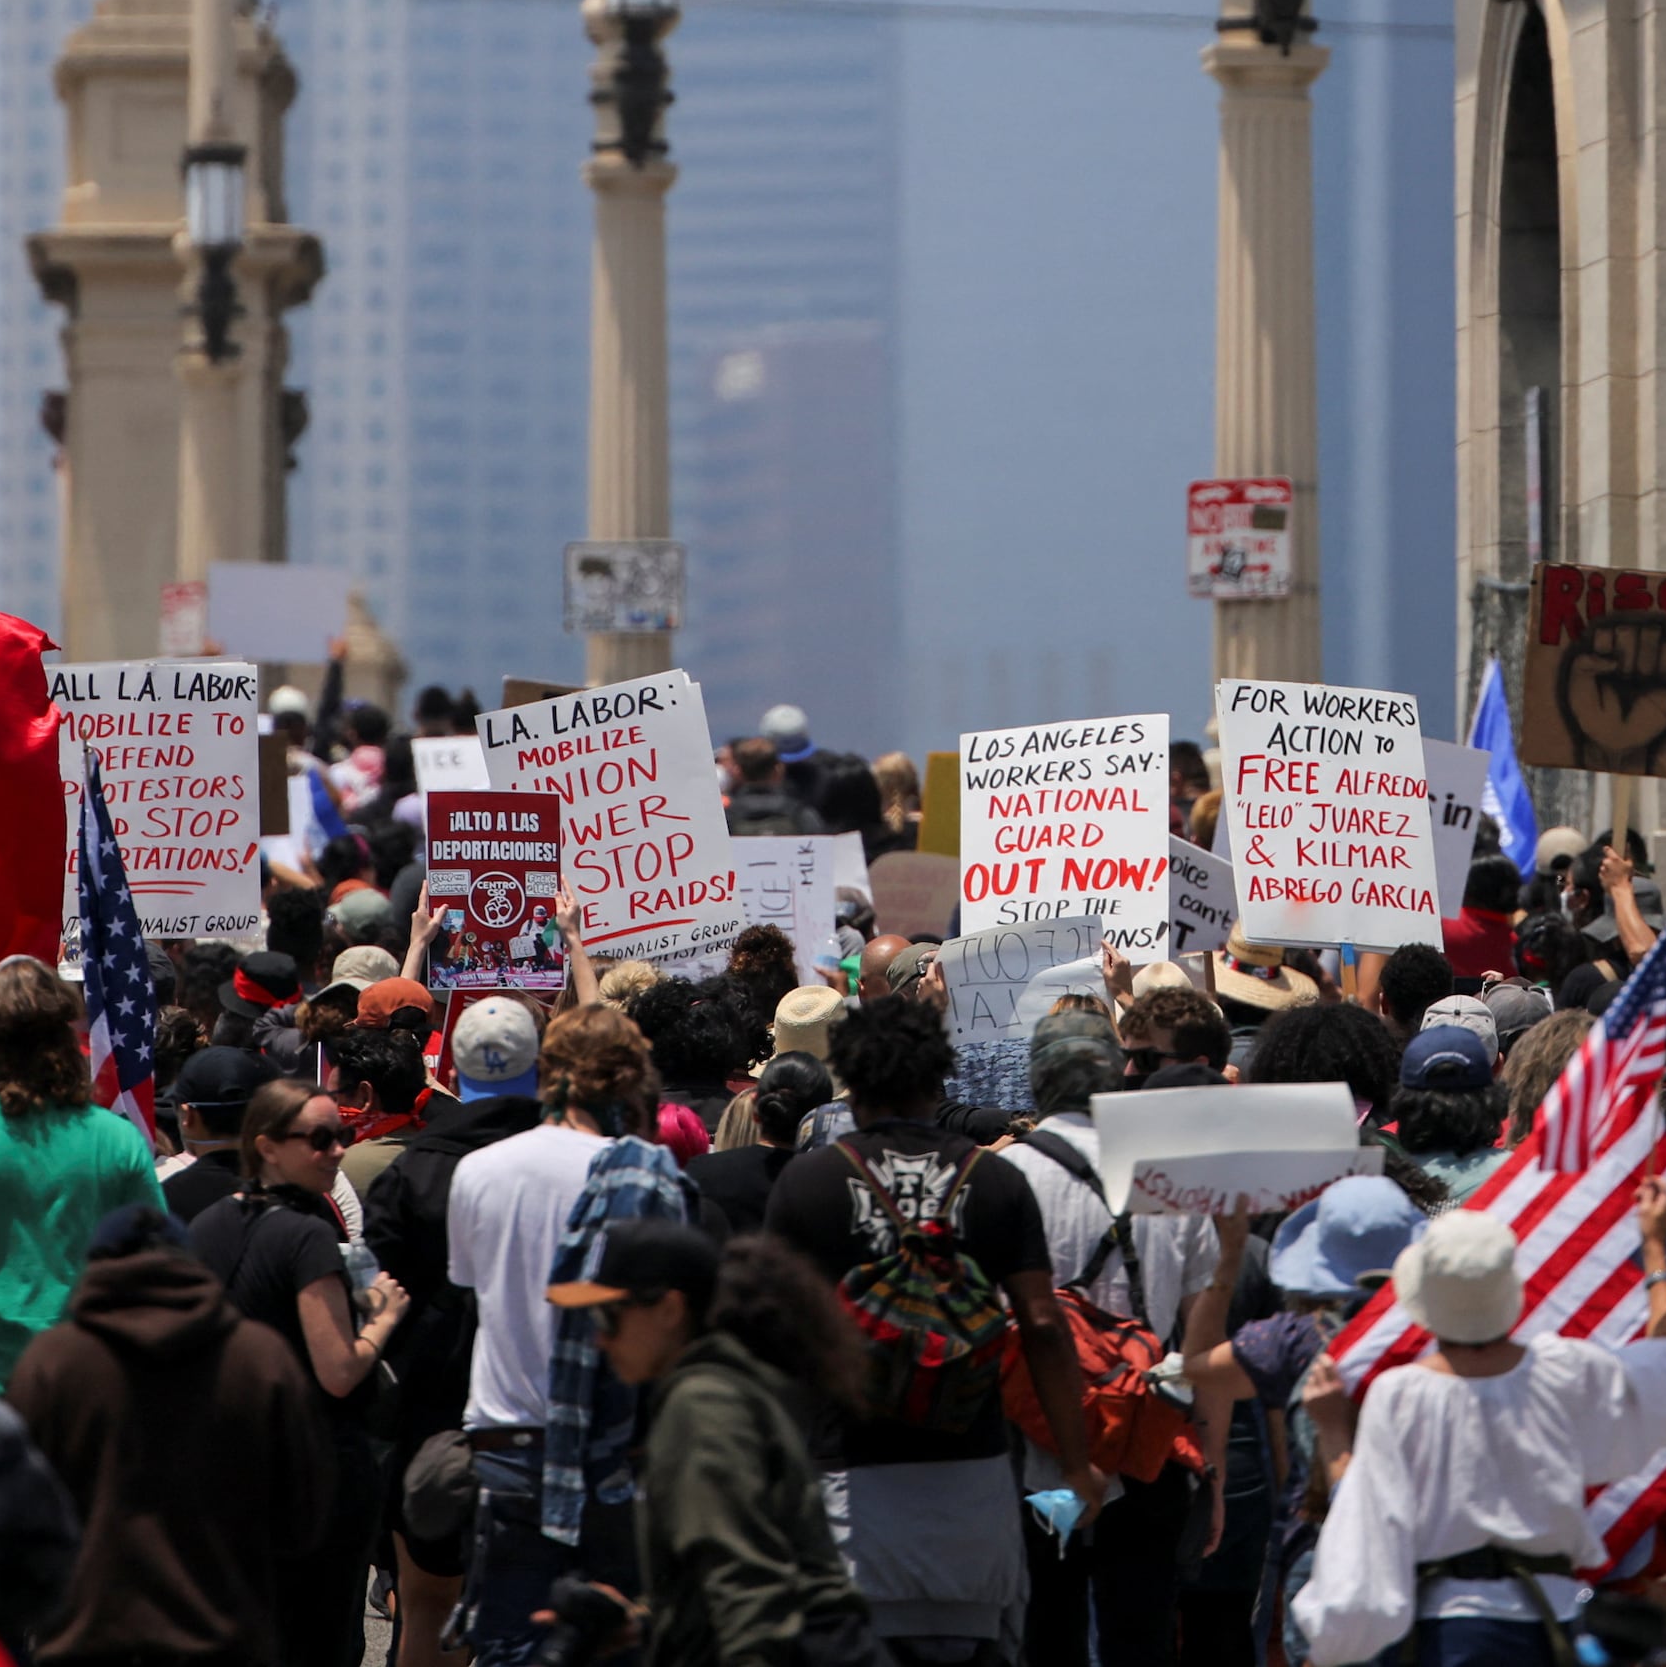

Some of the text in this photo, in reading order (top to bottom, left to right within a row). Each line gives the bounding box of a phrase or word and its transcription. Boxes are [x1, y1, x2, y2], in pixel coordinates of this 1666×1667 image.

[50, 671, 257, 702] ALL L.A. LABOR:
[486, 684, 677, 749] L.A. LABOR:
[1232, 685, 1416, 727] FOR WORKERS
[60, 711, 245, 742] MOBILIZE TO
[968, 723, 1144, 763] LOS ANGELES
[1266, 722, 1363, 756] ACTION
[517, 726, 647, 770] MOBILIZE
[966, 752, 1164, 790] WORKERS SAY:
[1236, 754, 1429, 799] FREE ALFREDO
[63, 775, 245, 805] POTESTORS
[988, 786, 1149, 819] NATIONAL
[141, 807, 240, 838] STOP
[449, 811, 539, 832] ¡ALTO A LAS
[1309, 803, 1419, 838] JUAREZ
[432, 840, 558, 862] DEPORTACIONES!
[994, 822, 1104, 854] GUARD
[1245, 834, 1413, 869] & KILMAR
[574, 832, 694, 893] STOP
[964, 857, 1168, 902] OUT NOW!
[1169, 855, 1210, 890] oice
[476, 881, 517, 890] CENTRO
[629, 870, 735, 920] RAIDS!
[1248, 875, 1436, 915] ABREGO GARCIA
[205, 915, 259, 932] GROUP
[996, 897, 1122, 925] STOP THE
[1178, 892, 1233, 932] can't
[690, 920, 740, 942] GROUP
[483, 1045, 507, 1074] LA
